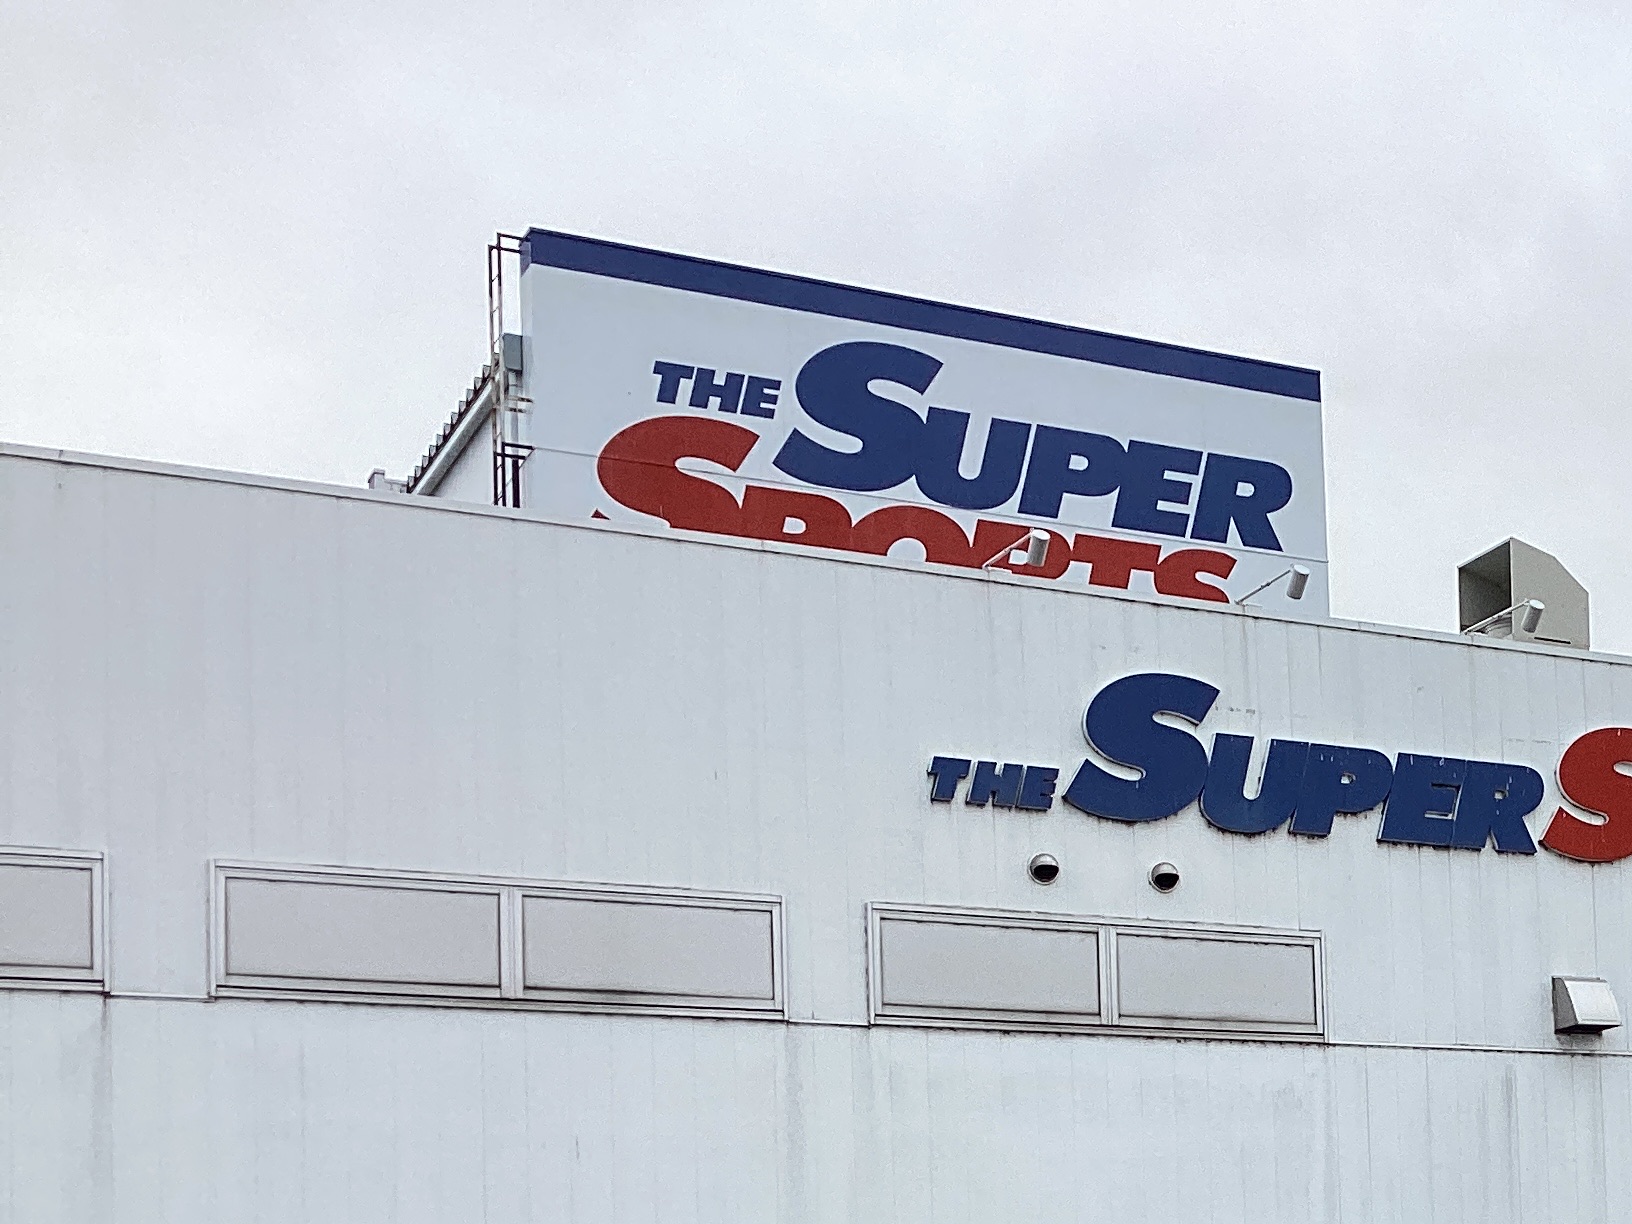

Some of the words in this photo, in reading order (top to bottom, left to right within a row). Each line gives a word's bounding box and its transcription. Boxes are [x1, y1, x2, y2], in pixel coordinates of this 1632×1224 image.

[652, 360, 782, 419] THE
[771, 341, 1293, 552] SUPER
[927, 756, 1060, 811] THE
[1062, 672, 1545, 855] SUPER
